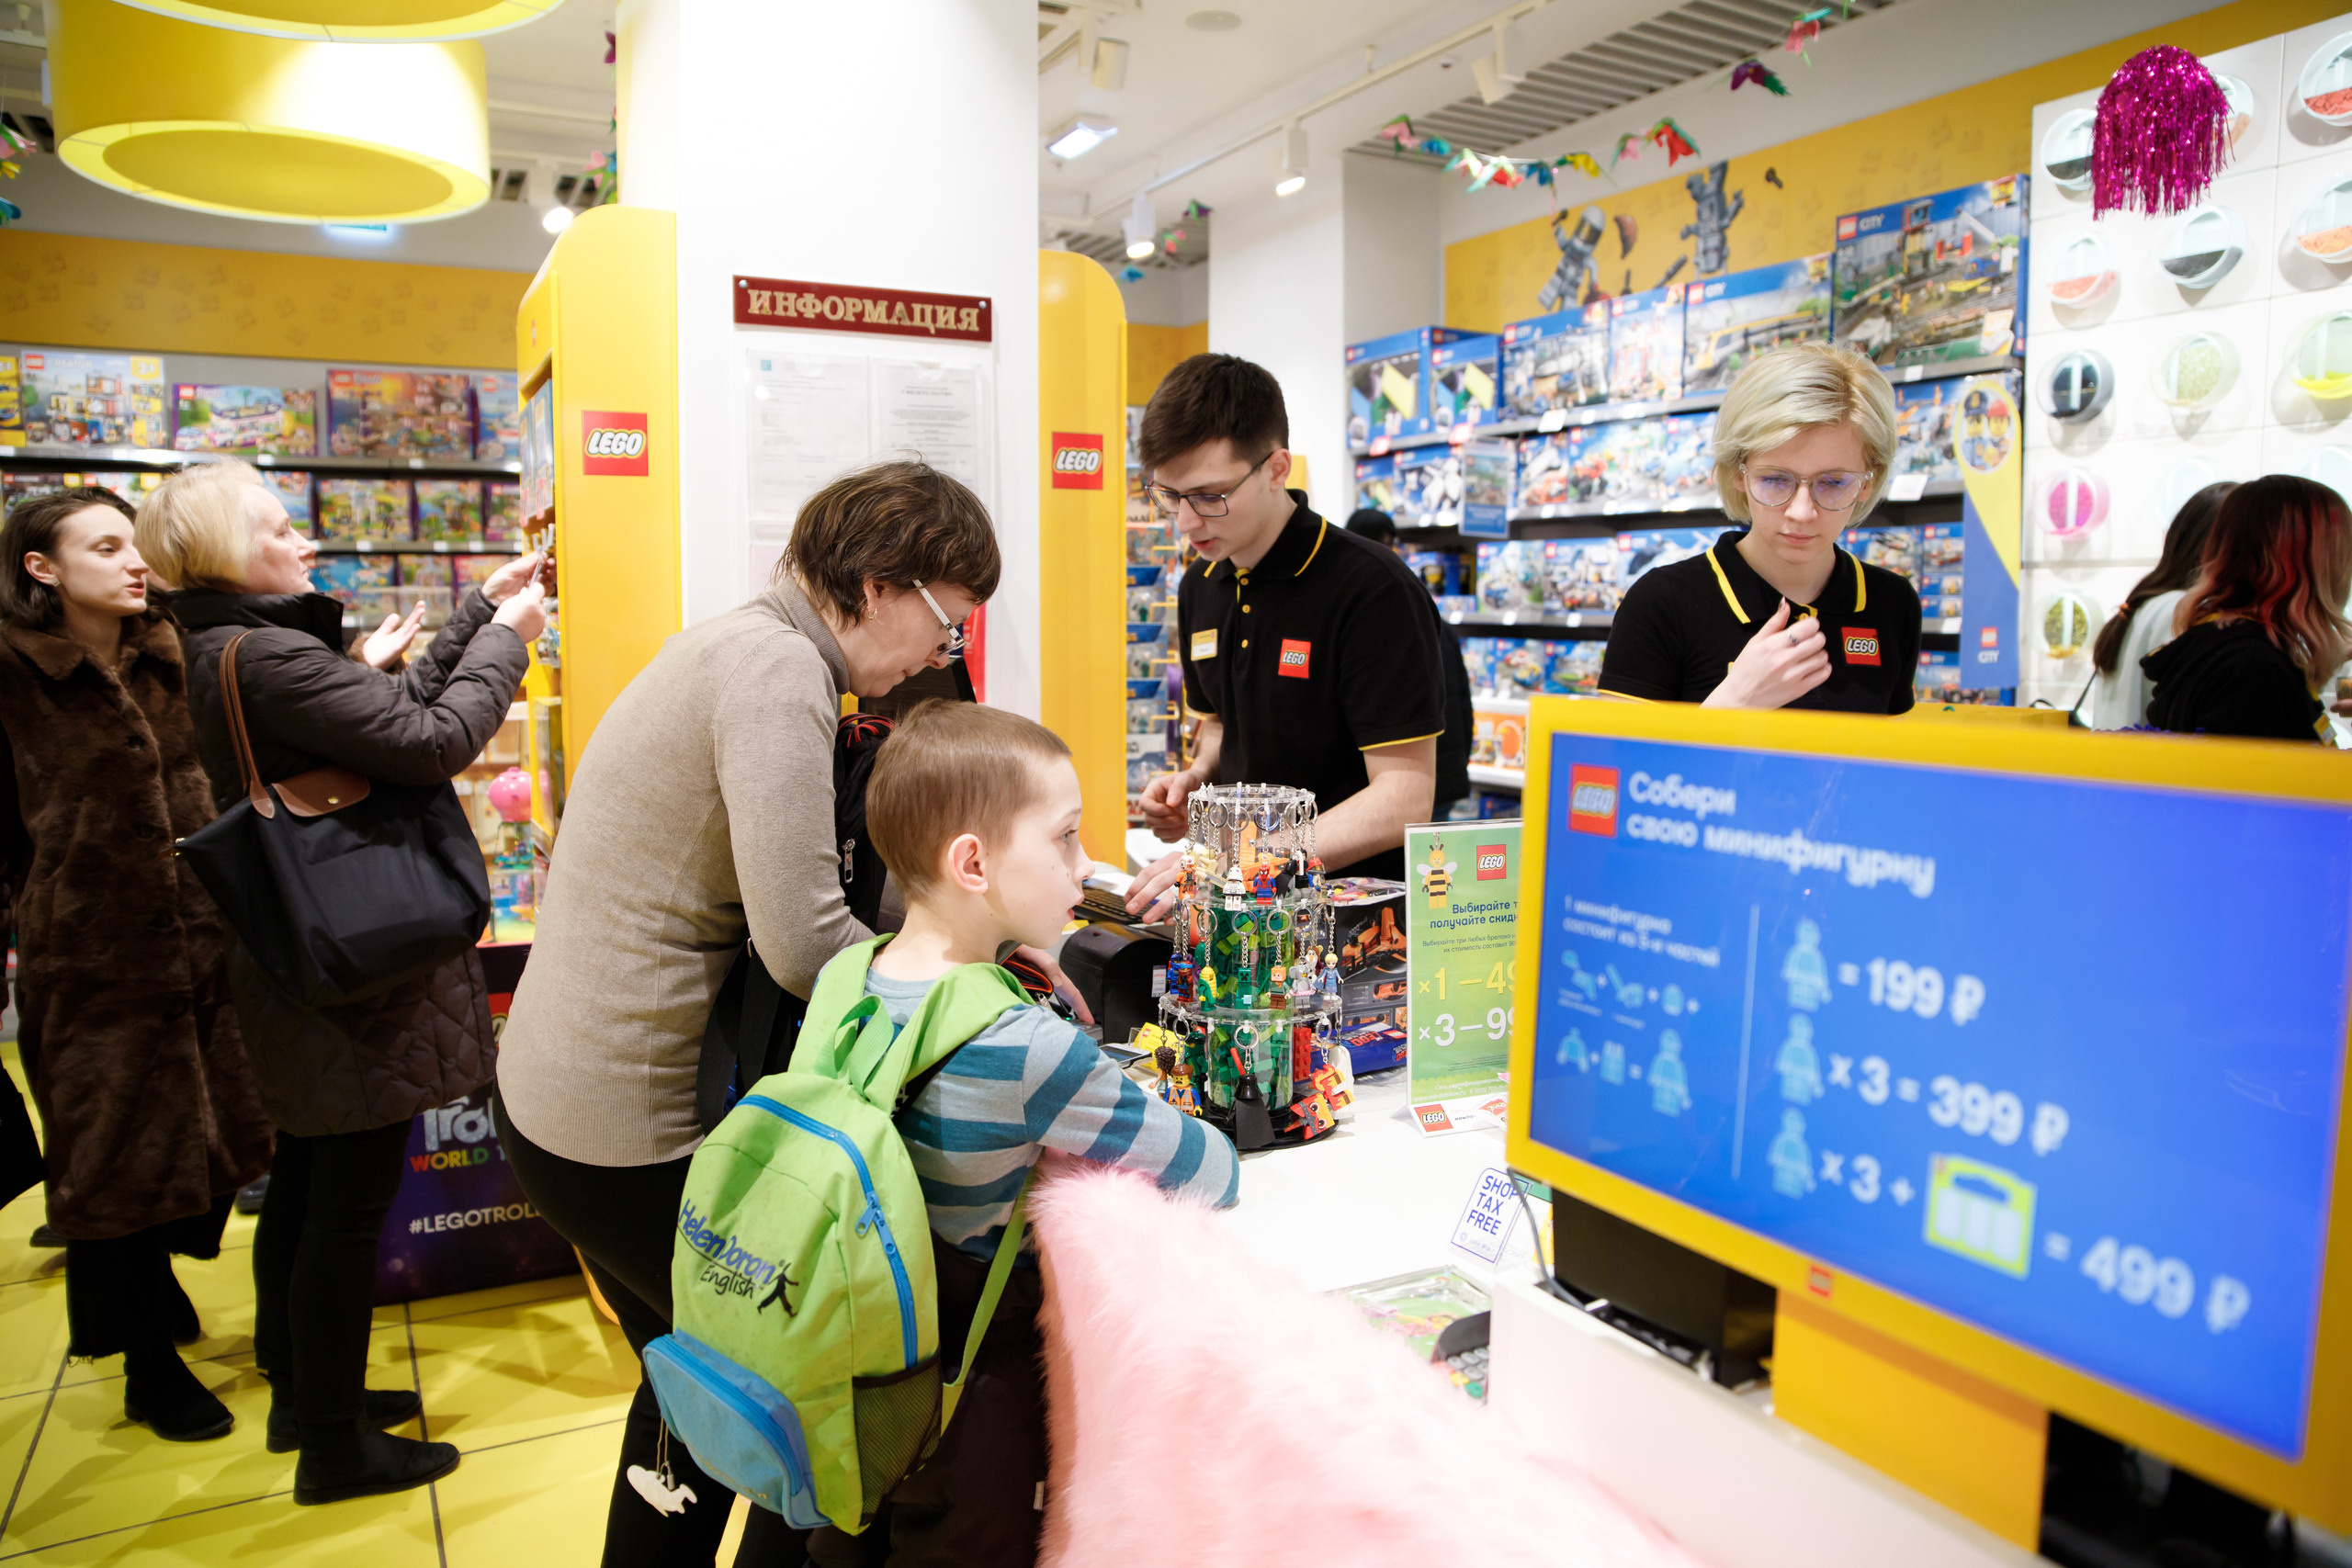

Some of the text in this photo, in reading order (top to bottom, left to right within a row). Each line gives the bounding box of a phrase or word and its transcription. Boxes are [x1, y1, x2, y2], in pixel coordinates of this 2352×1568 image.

[747, 288, 980, 334] ИНФОРМАЦИЯ
[586, 430, 645, 457] LEGO
[1055, 449, 1101, 473] LEGO
[1282, 650, 1306, 667] LEGO
[1846, 637, 1877, 655] LEGO
[1978, 650, 1999, 663] CITY
[1571, 784, 1615, 817] LEGO
[1628, 771, 1736, 820] Собери
[1625, 813, 1700, 848] свою
[1478, 854, 1505, 870] LEGO
[1452, 900, 1510, 914] Выбирайте
[1430, 915, 1487, 930] получайте
[1422, 938, 1455, 947] Выбирайте
[1451, 944, 1481, 953] стоимость
[1867, 956, 1945, 1020] 199
[1857, 1055, 1891, 1106] 3
[1928, 1074, 2024, 1146] 399
[1421, 1111, 1446, 1124] LEGO
[410, 1147, 489, 1173] WORLD
[1476, 1192, 1504, 1215] TAX
[678, 1198, 726, 1258] Helen
[1466, 1209, 1502, 1235] FREE
[1849, 1154, 1882, 1204] 3
[2080, 1235, 2196, 1319] 499
[700, 1264, 754, 1300] English
